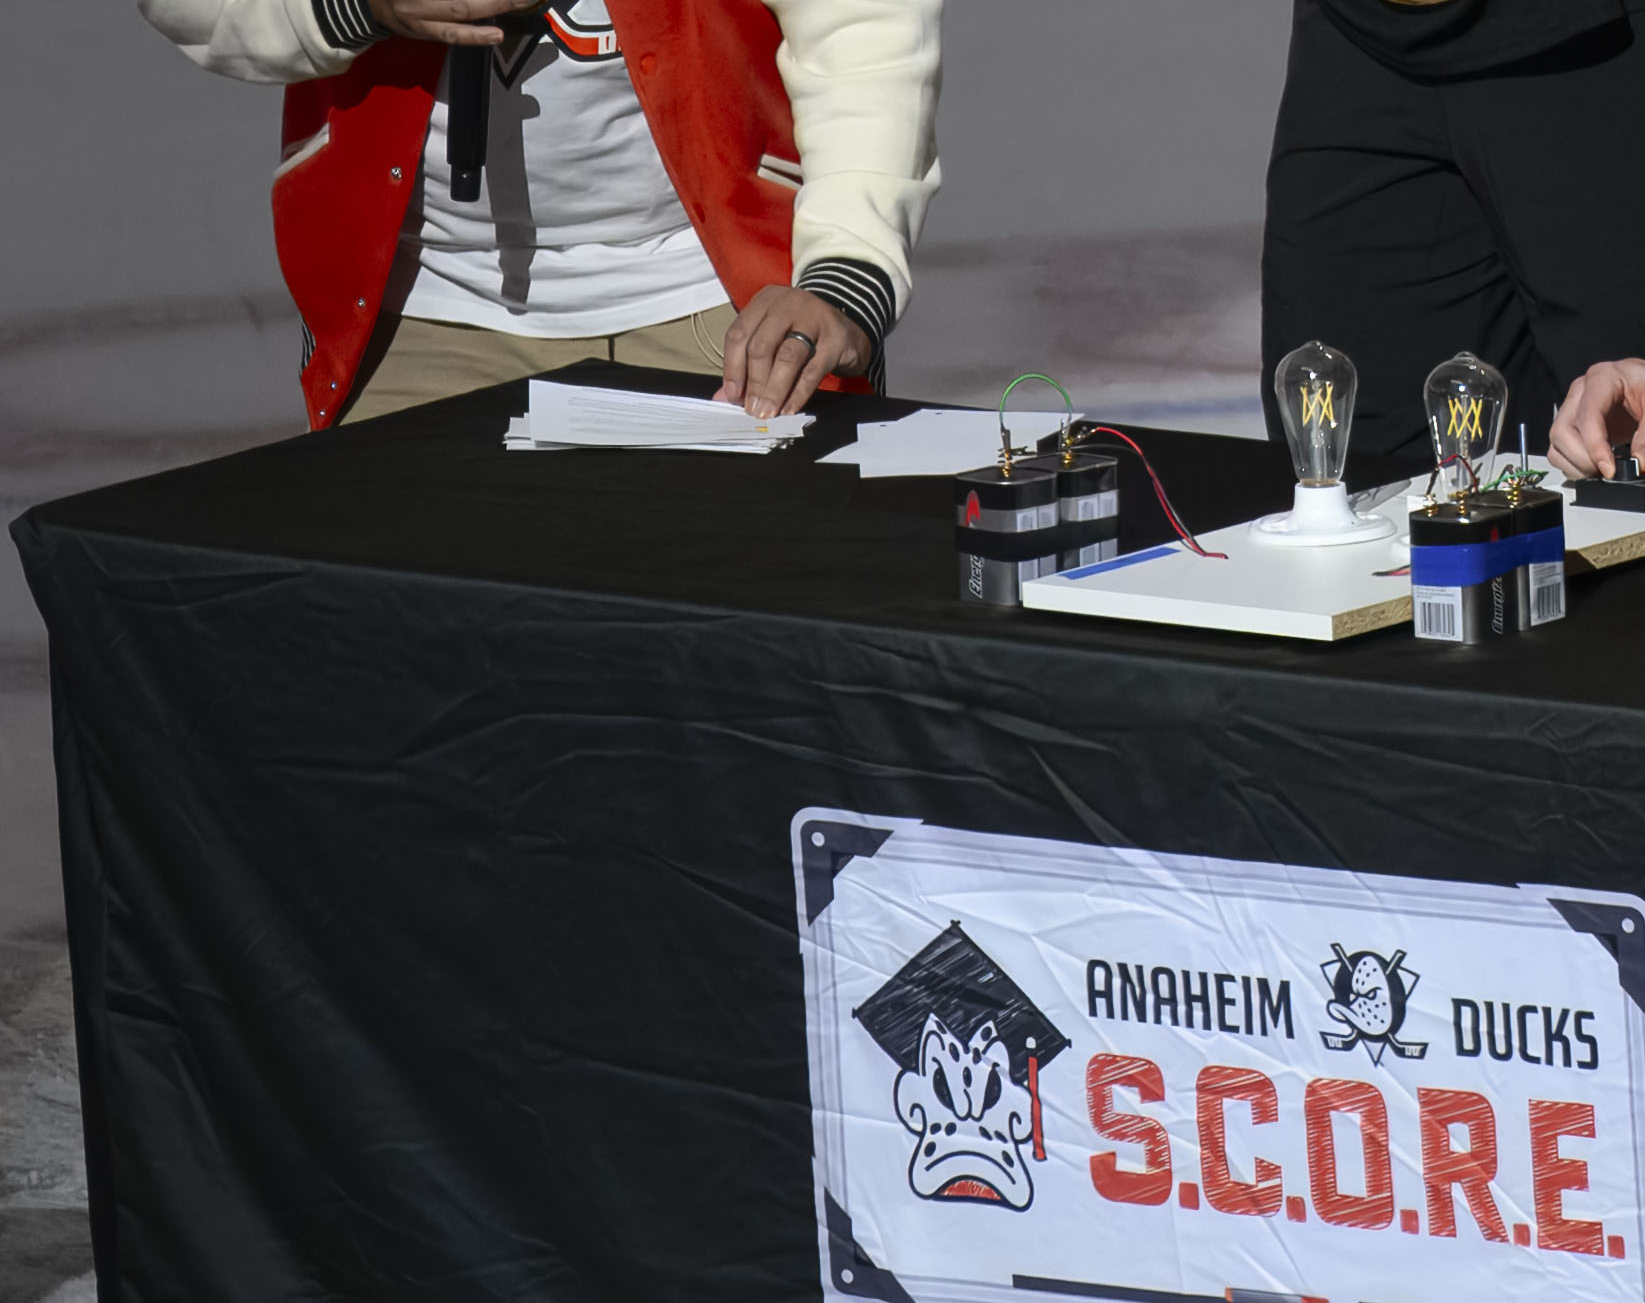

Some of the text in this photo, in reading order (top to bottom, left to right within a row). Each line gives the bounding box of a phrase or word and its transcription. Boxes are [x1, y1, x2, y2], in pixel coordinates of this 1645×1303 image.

[968, 553, 985, 599] Energ
[1086, 959, 1599, 1071] ANAHEIM DUCKS
[1086, 1052, 1626, 1260] S.C.O.R.E.
